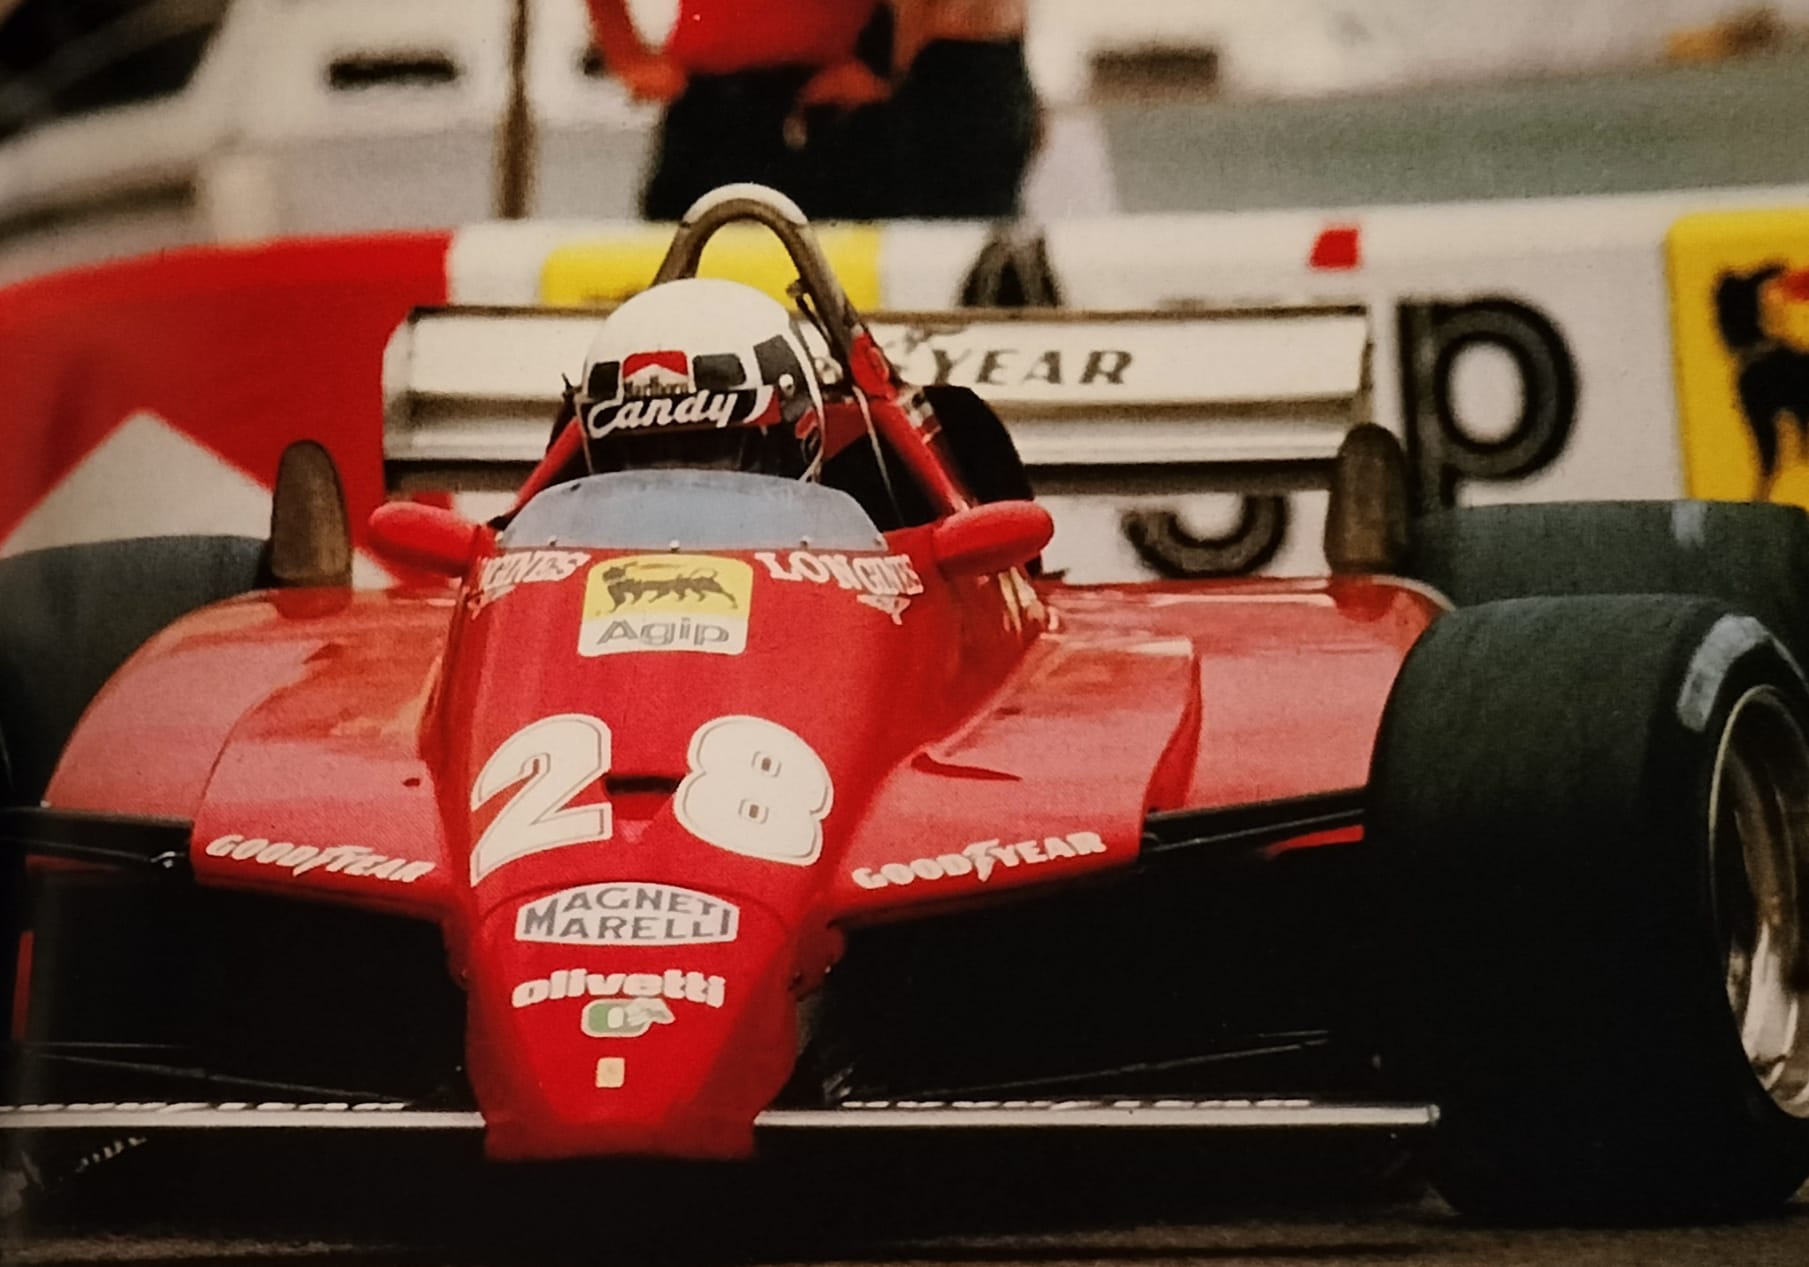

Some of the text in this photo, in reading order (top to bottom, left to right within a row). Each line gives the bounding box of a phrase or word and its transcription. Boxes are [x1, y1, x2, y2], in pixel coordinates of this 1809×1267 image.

[931, 348, 1134, 386] YEAR
[587, 389, 738, 440] Candy
[754, 551, 925, 596] LONGINES
[596, 618, 731, 648] Agip
[205, 833, 437, 884] GOODYEAR
[851, 830, 1108, 890] GOODYEAR
[522, 886, 732, 924] MAGNETI
[522, 907, 732, 940] MARELLI
[511, 967, 727, 1009] olivetti
